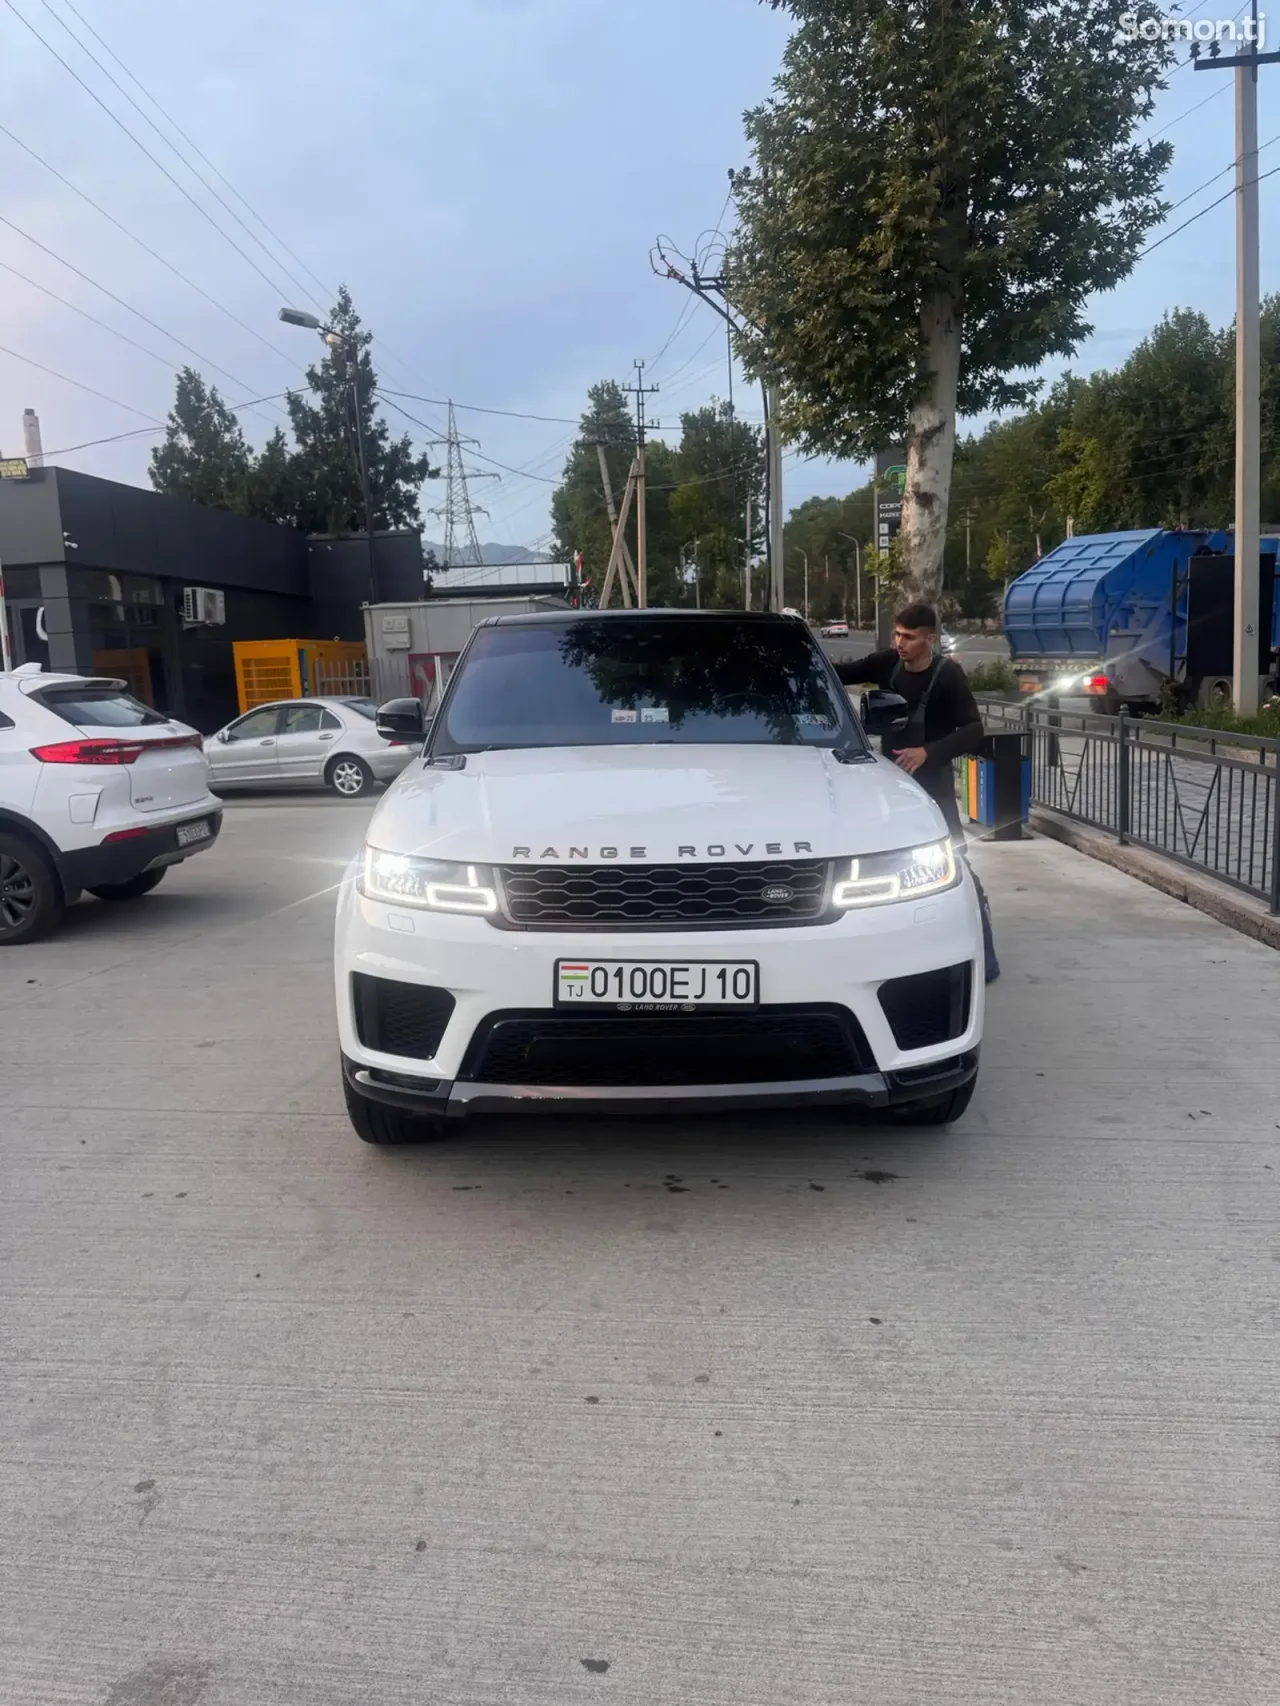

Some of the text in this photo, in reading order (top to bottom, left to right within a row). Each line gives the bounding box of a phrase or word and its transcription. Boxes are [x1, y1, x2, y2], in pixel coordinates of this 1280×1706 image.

[512, 841, 814, 859] RANGE ROVER
[567, 985, 583, 997] TJ
[590, 966, 750, 1000] 0100EJ10
